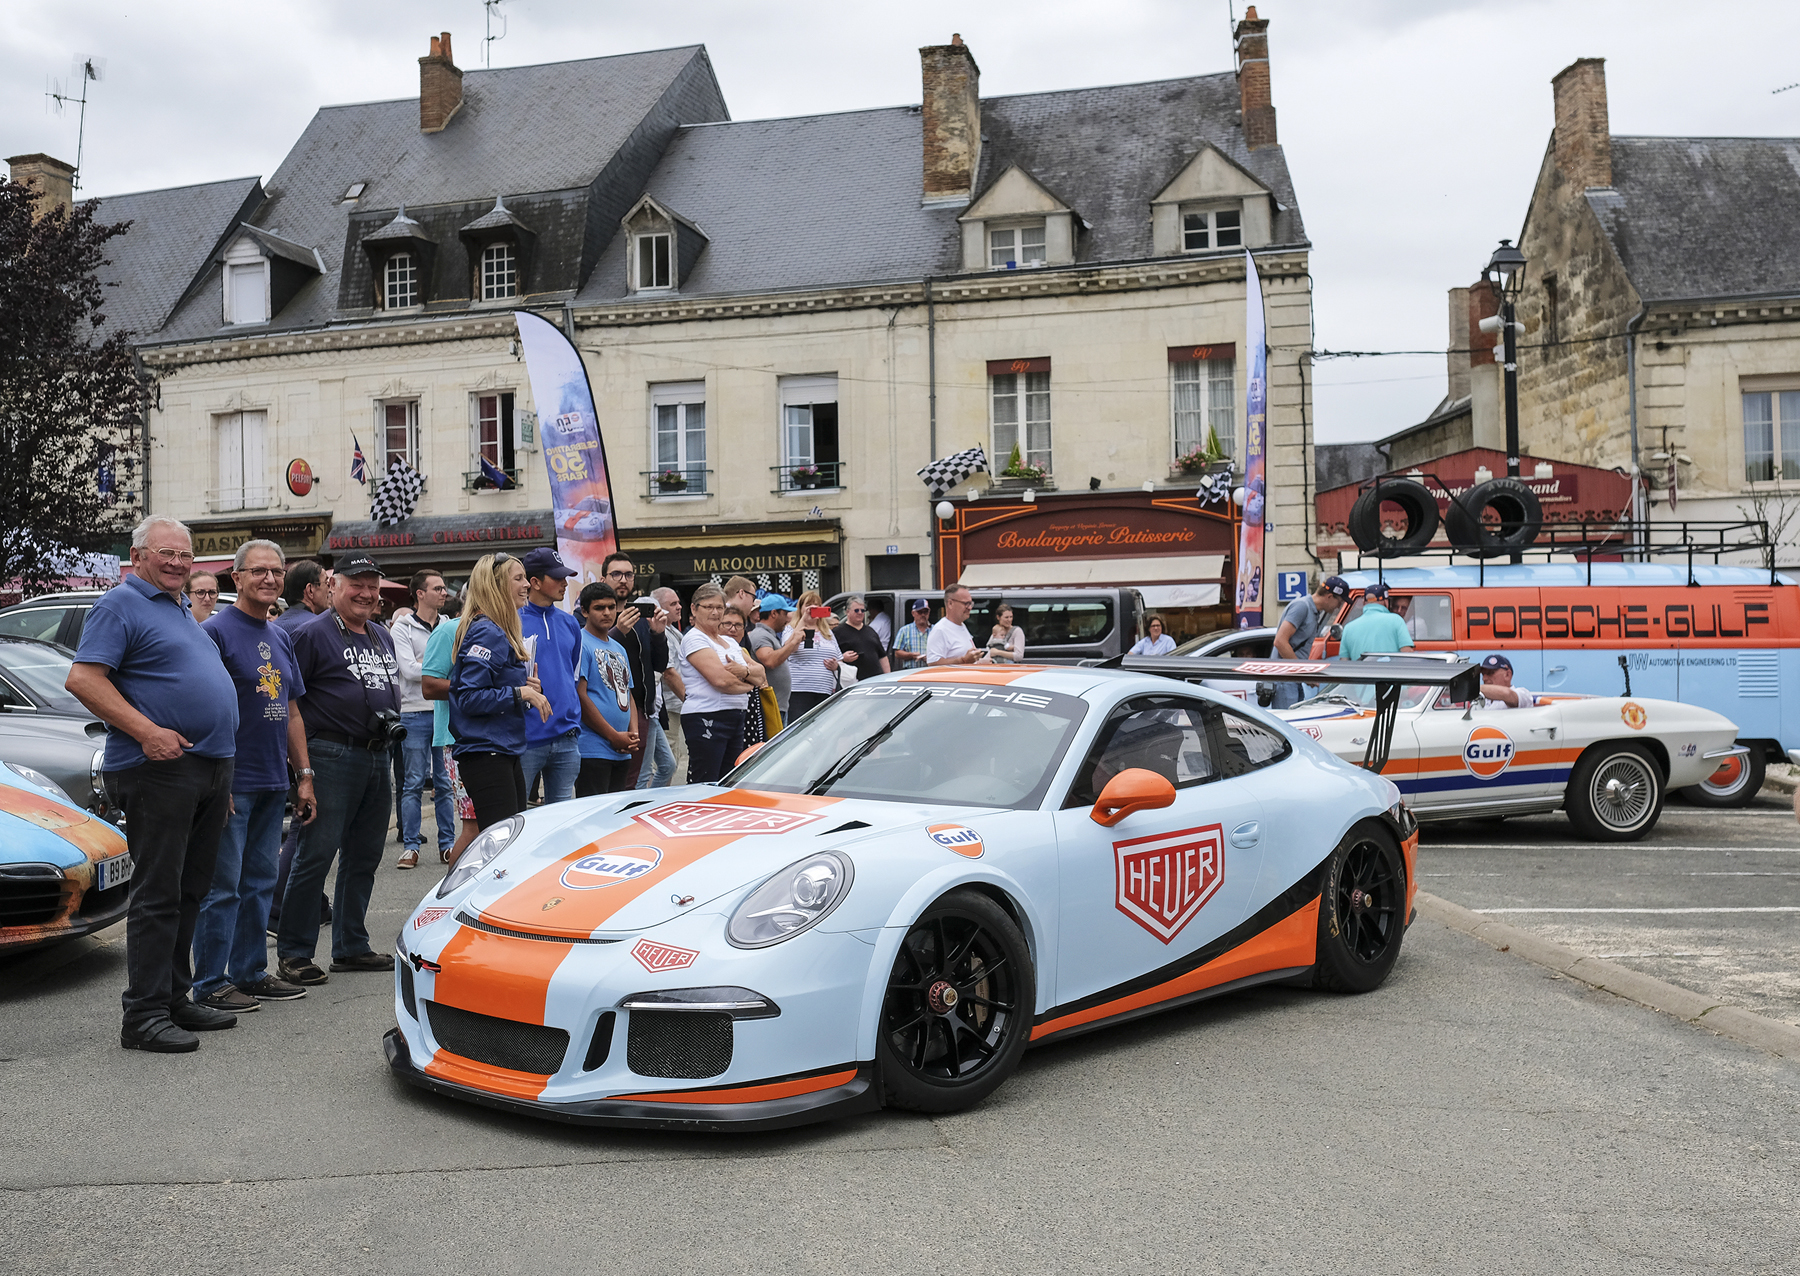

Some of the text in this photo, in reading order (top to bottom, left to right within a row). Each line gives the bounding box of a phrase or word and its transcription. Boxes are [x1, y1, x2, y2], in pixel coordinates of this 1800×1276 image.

[329, 525, 544, 549] BOUCHERIE CHARCUTERIE
[997, 526, 1197, 552] Boulangerie Patisserie
[693, 554, 828, 572] MAROQUINERIE
[1285, 573, 1301, 592] P
[1628, 653, 1649, 671] JW
[1649, 658, 1685, 666] AUTOMOTIVE
[1686, 658, 1725, 666] ENGINEERING
[841, 686, 1053, 709] PORSCHE
[1466, 744, 1511, 758] Gulf
[657, 805, 793, 831] HEUER
[933, 830, 978, 844] Gulf
[575, 857, 650, 876] Gulf
[1129, 845, 1214, 921] HEUER
[640, 945, 690, 967] HEUER
